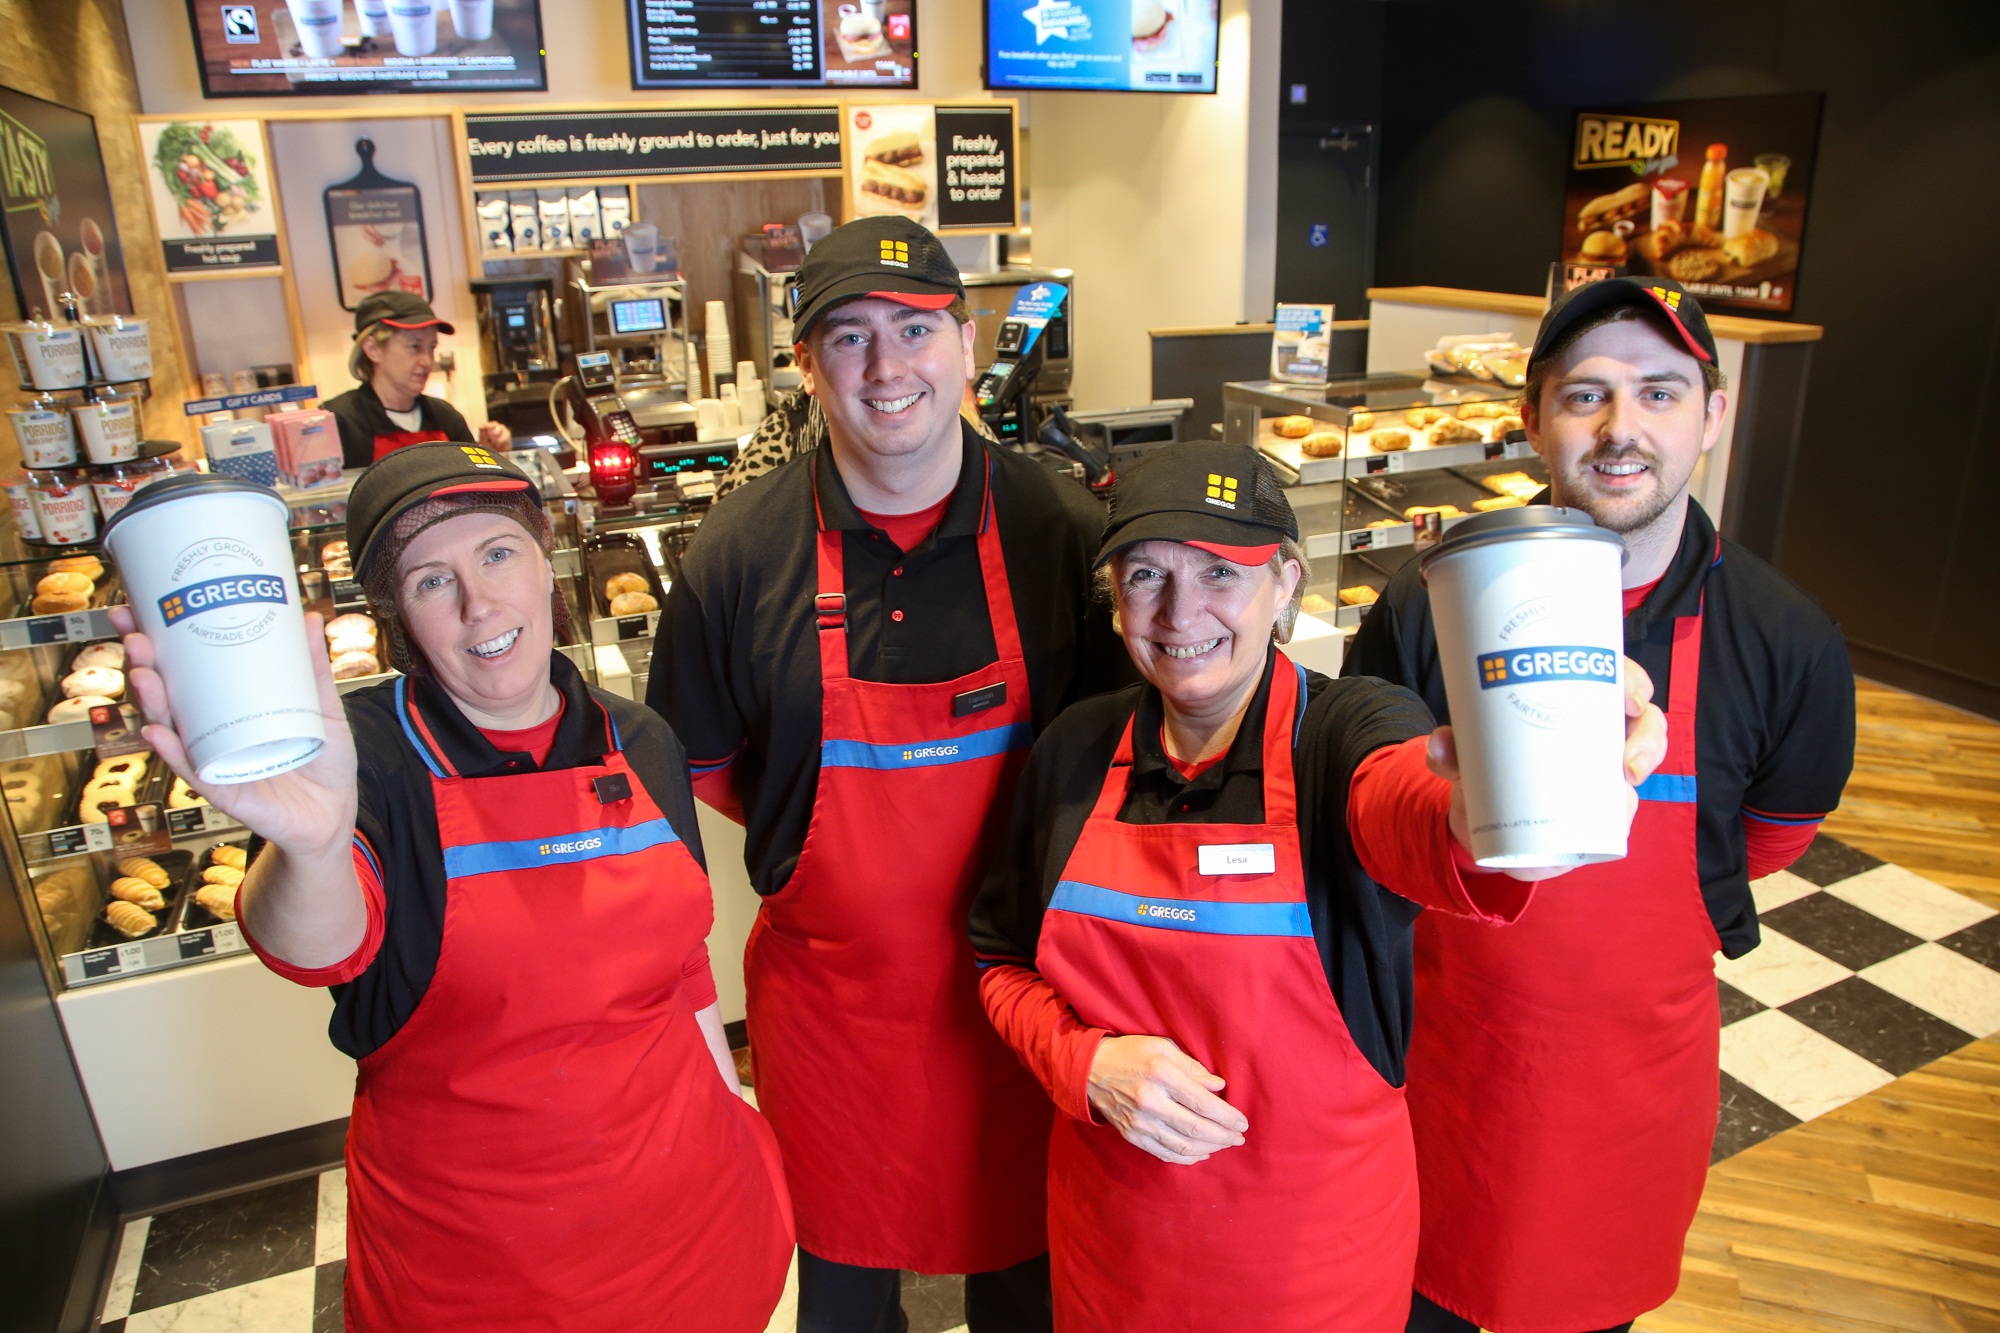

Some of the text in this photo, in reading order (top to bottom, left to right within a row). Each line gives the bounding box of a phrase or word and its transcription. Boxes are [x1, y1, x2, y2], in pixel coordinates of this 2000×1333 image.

[468, 127, 840, 159] Every coffee is freshly ground to order, just for you
[953, 134, 998, 154] Freshly
[1580, 119, 1675, 161] READY
[946, 150, 1005, 172] prepared
[946, 168, 1005, 186] & heated
[950, 184, 1002, 202] to order
[183, 240, 256, 254] Freshly prepared
[226, 396, 248, 408] GIFT
[250, 392, 283, 405] CARDS
[22, 420, 67, 438] PORRIDGE
[42, 499, 86, 516] PORRIDGE
[1205, 497, 1236, 510] GREGGS
[171, 542, 264, 583] FRESHLY GROUND
[186, 578, 283, 608] GREGGS
[187, 608, 277, 641] FAIRTRADE COFFEE
[1511, 651, 1615, 677] GREGGS
[210, 722, 229, 735] LATTE
[235, 713, 263, 724] MOCHA
[913, 745, 959, 759] GREGGS
[551, 837, 602, 854] GREGGS
[1226, 855, 1248, 865] Lesa
[1149, 905, 1196, 922] GREGGS
